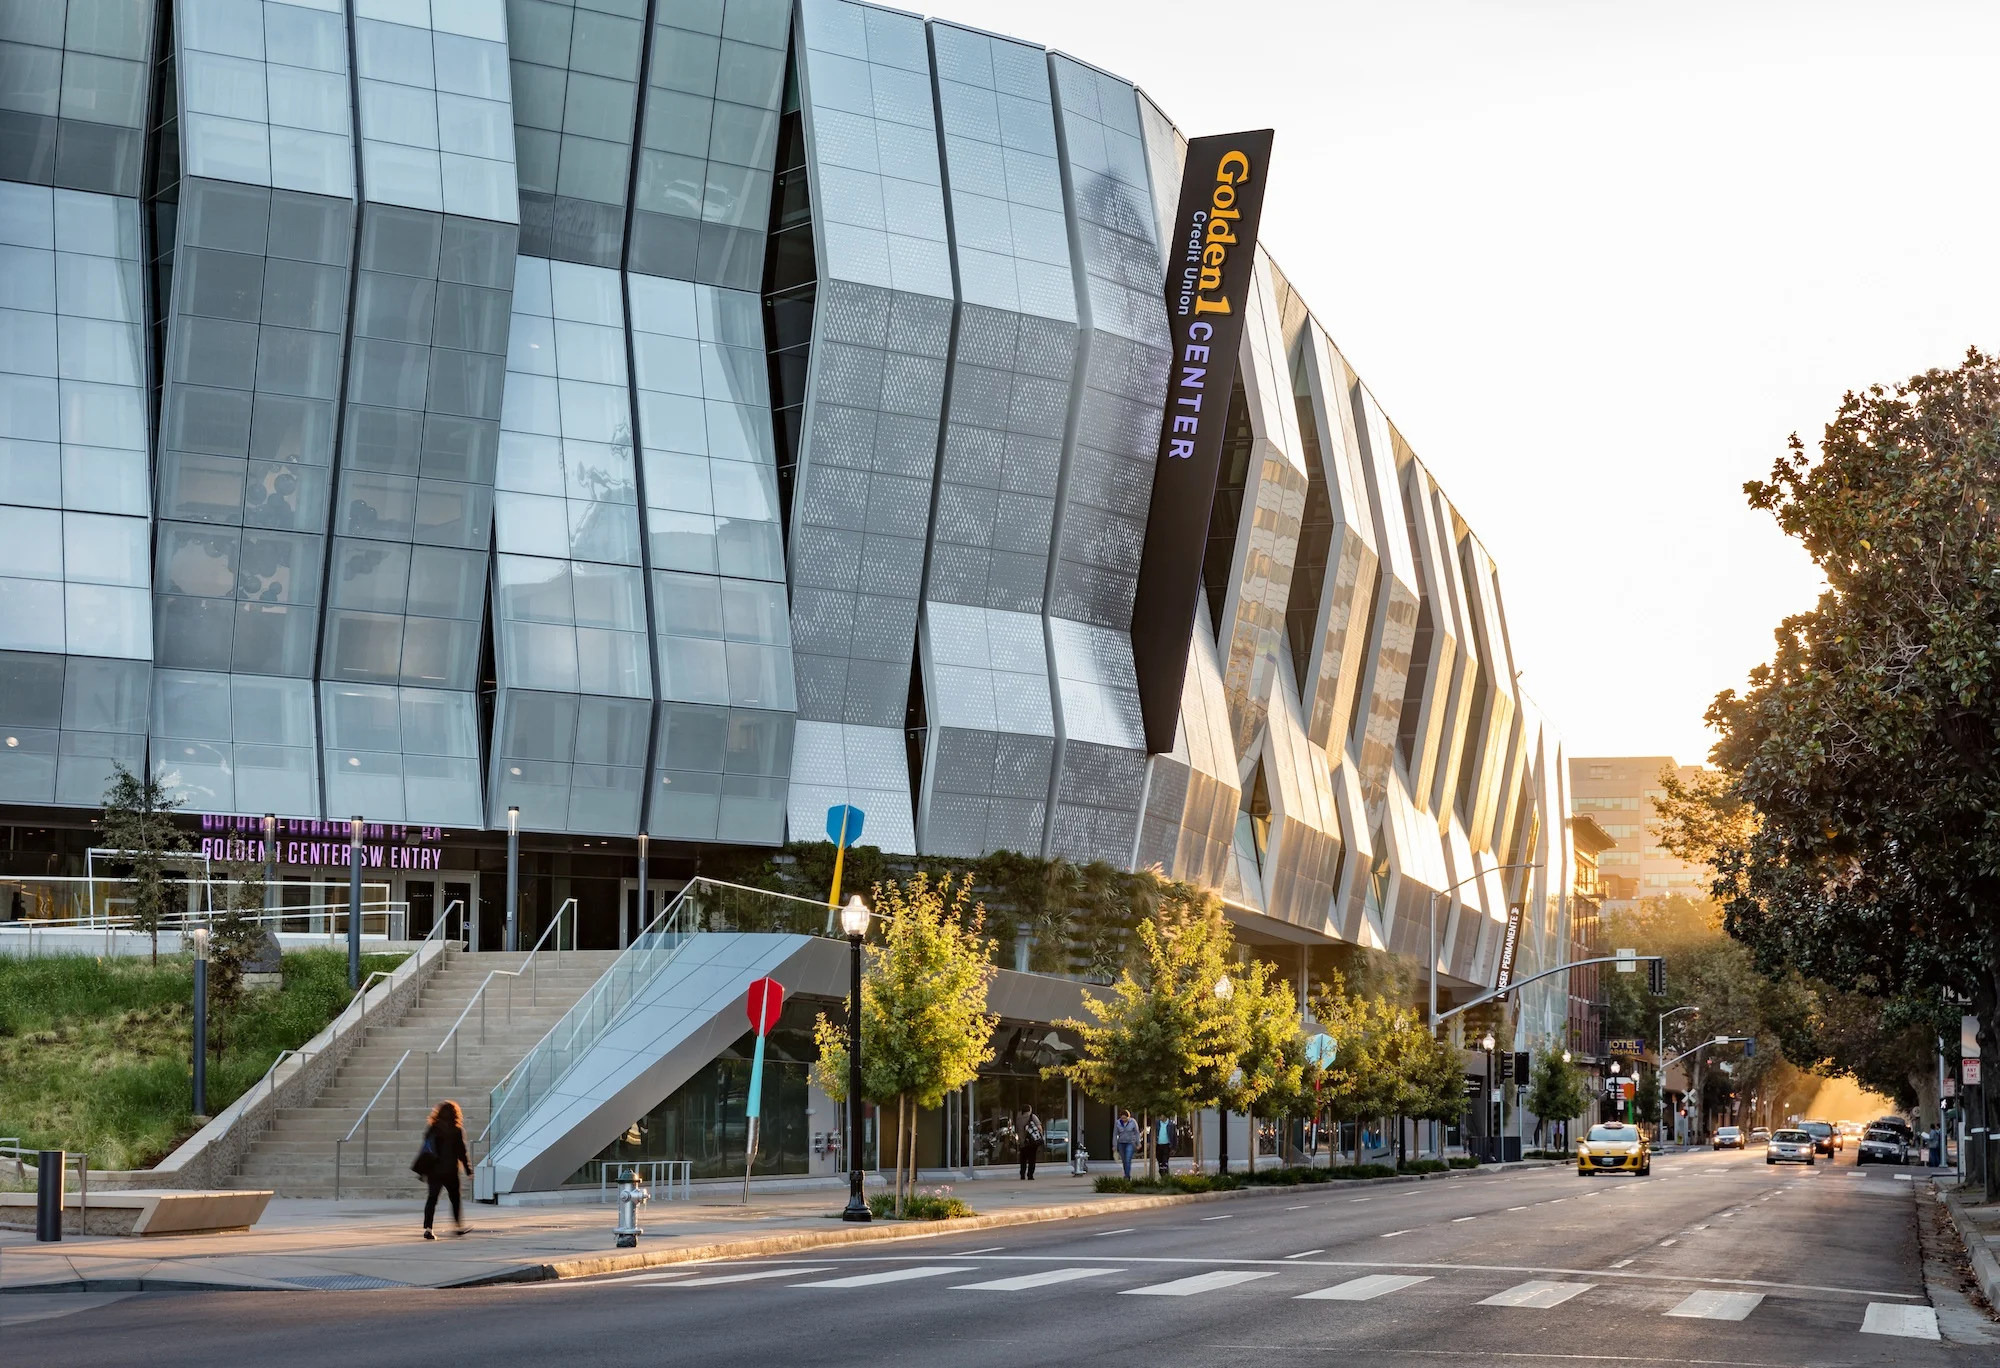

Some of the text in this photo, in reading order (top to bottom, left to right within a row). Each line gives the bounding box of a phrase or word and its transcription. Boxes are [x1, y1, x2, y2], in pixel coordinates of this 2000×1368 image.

[1178, 210, 1207, 316] Credit Union
[1168, 321, 1213, 459] CENTER
[288, 841, 351, 866] CENTER
[361, 844, 384, 868] SW
[390, 847, 442, 870] ENTRY
[1502, 915, 1519, 969] PERMANENTE
